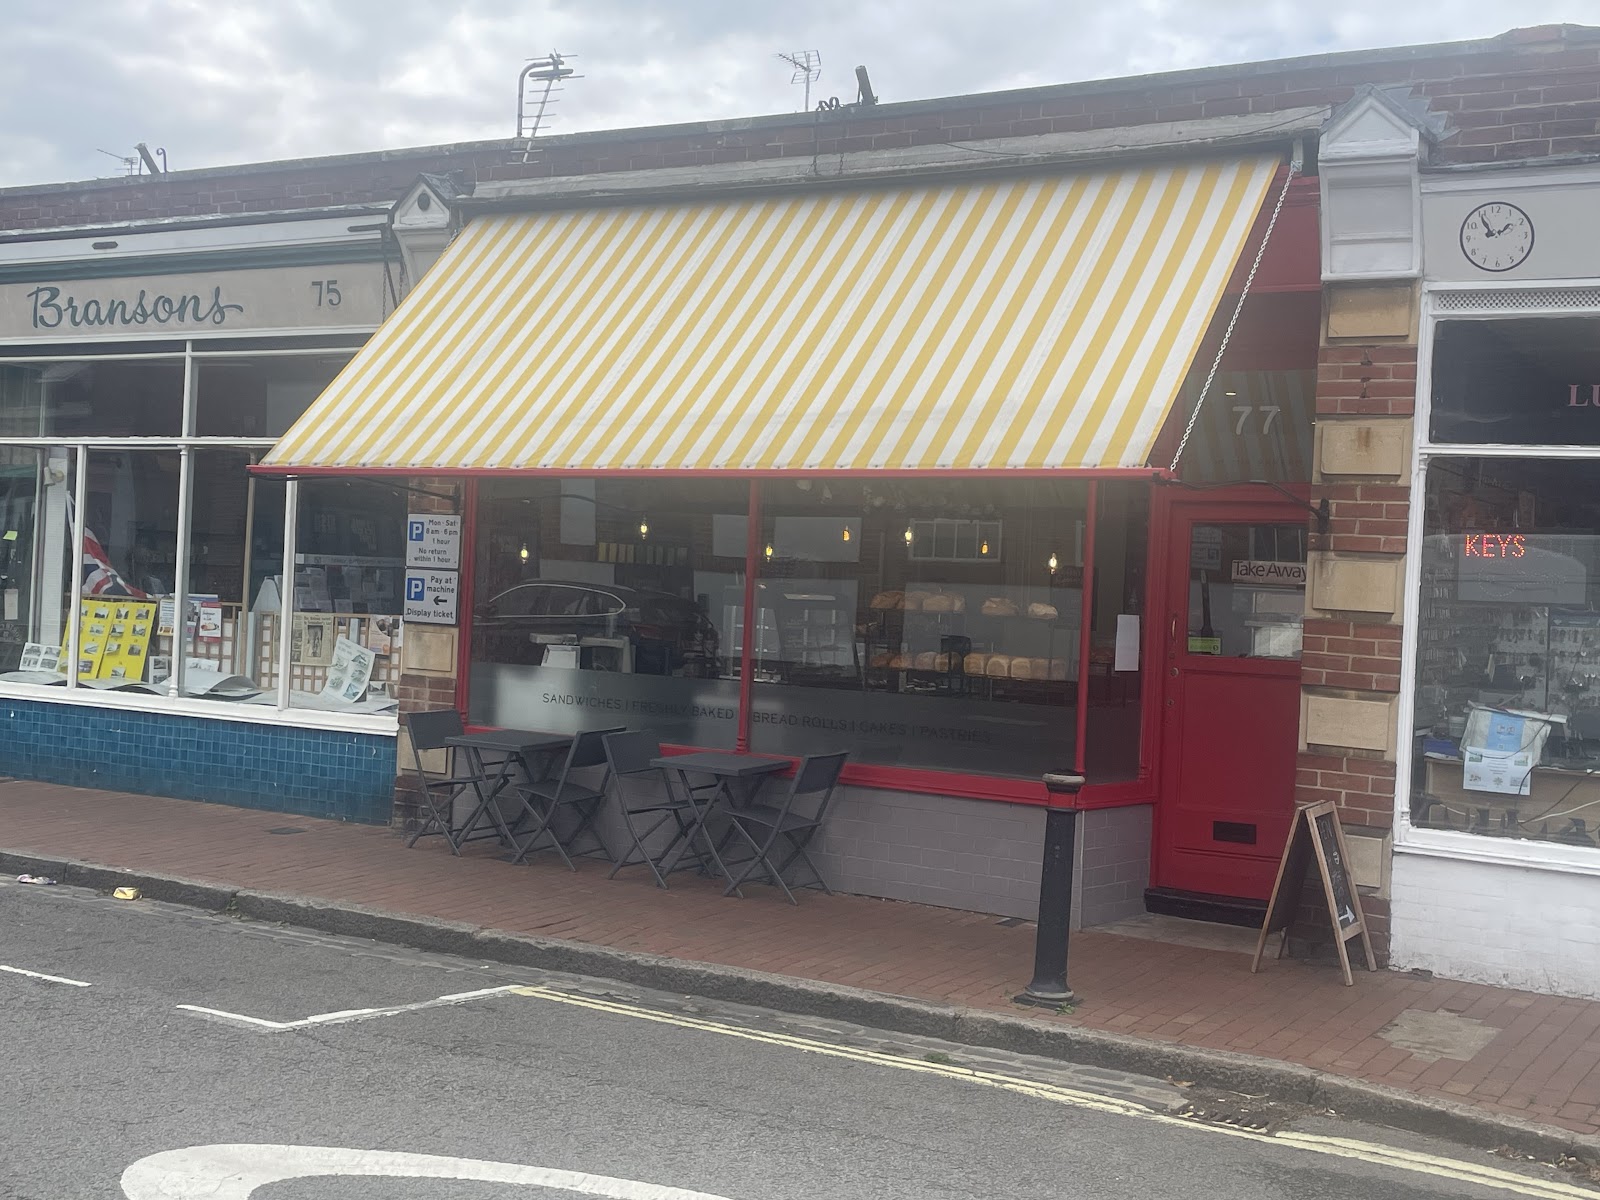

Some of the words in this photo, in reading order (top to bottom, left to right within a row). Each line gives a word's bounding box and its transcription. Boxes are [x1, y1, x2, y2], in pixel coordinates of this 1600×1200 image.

[1519, 218, 1524, 226] 2
[1524, 232, 1528, 240] 3
[1518, 246, 1524, 254] 4
[1496, 260, 1500, 268] 6
[1510, 256, 1514, 264] 5
[311, 279, 342, 307] 75
[27, 285, 244, 329] Bransons
[1232, 406, 1280, 435] 77
[1466, 534, 1526, 558] KEYS
[1232, 561, 1266, 577] Take
[1266, 562, 1307, 582] Away
[430, 576, 442, 584] Pay
[426, 586, 455, 594] machine
[406, 608, 432, 618] Display
[433, 610, 454, 619] ticket
[542, 692, 622, 710] SANDWICHES
[632, 700, 688, 716] FRESHLY
[692, 706, 734, 720] BAKED
[752, 712, 798, 726] BREAD
[802, 716, 848, 730] ROLLS
[860, 720, 906, 735] CAKES
[920, 726, 992, 742] PASTRIES
